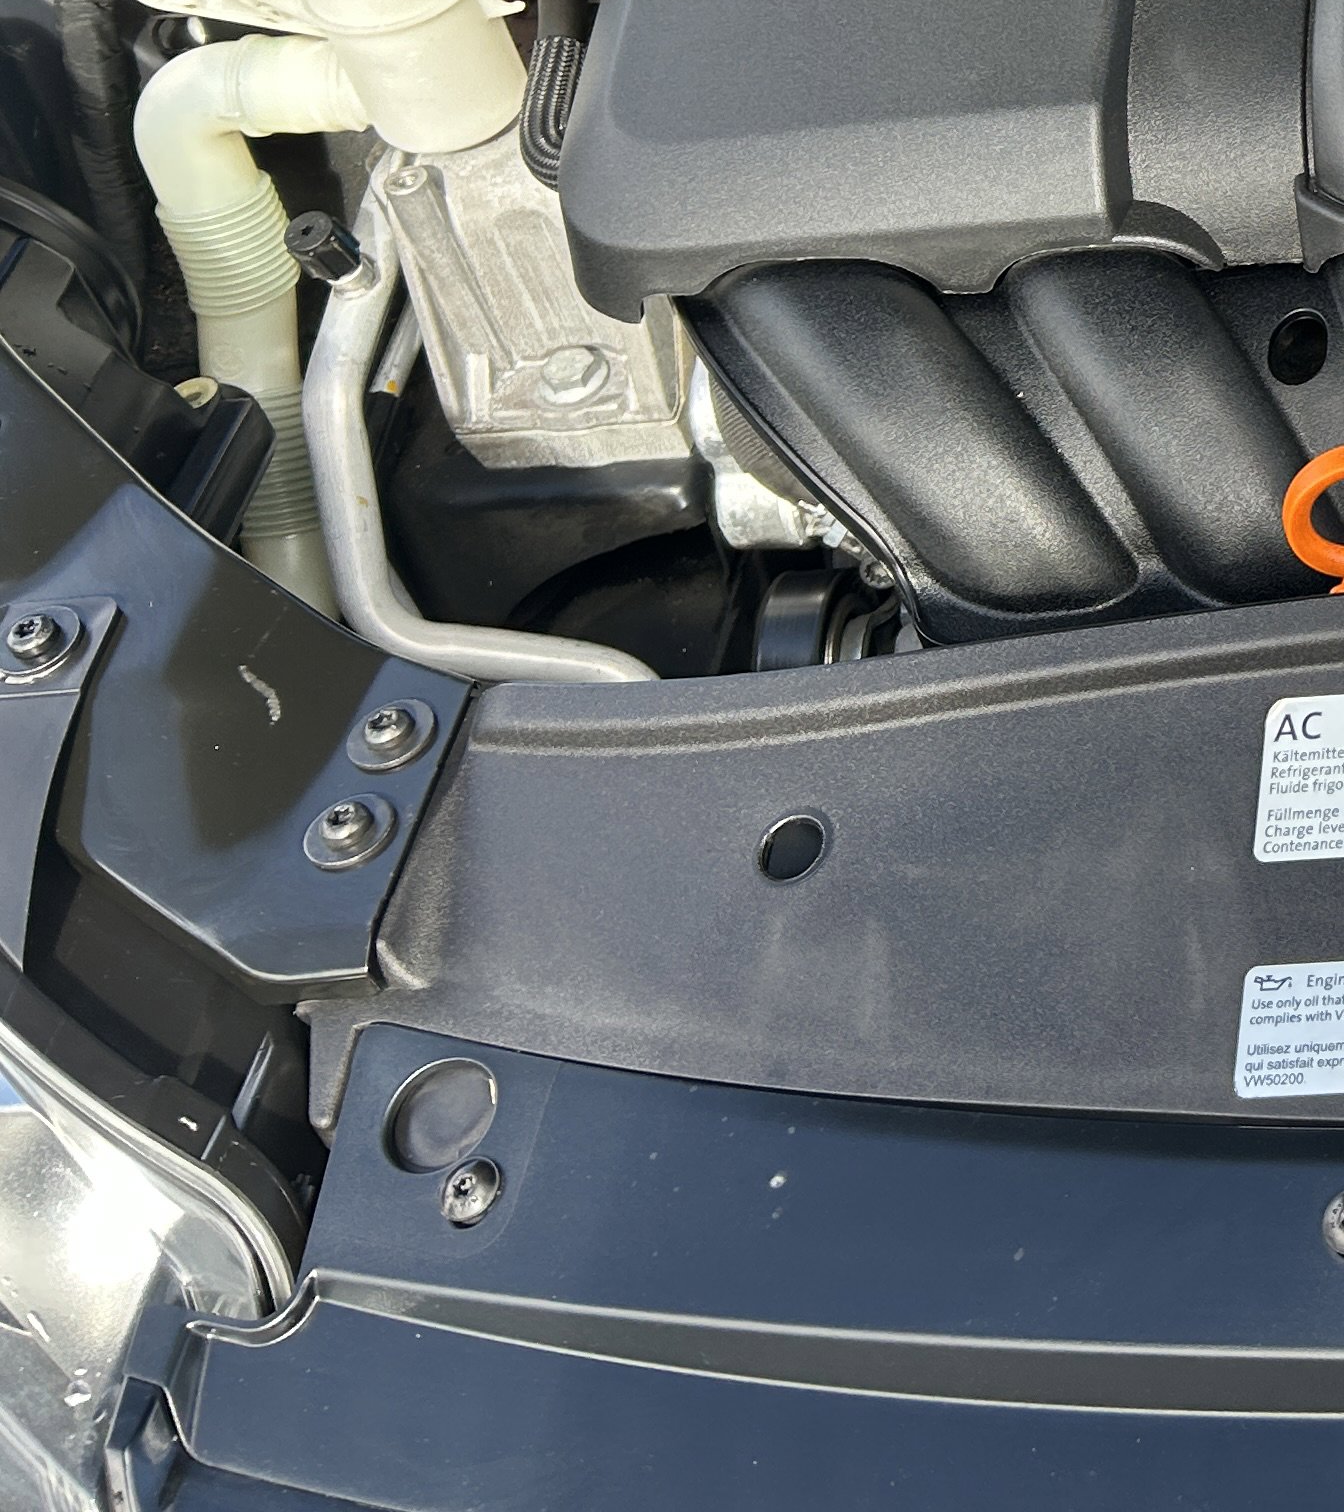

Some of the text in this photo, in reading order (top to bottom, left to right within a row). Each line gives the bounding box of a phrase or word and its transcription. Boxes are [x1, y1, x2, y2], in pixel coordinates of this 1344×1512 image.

[1273, 711, 1322, 742] AC
[1269, 780, 1309, 795] Fluide
[1266, 805, 1339, 825] Füllmenge
[1264, 822, 1313, 841] Charge
[1262, 837, 1343, 854] Contenance
[1251, 998, 1273, 1009] Use
[1275, 996, 1301, 1011] only
[1249, 1011, 1302, 1028] complies
[1304, 1010, 1332, 1022] with
[1246, 1042, 1290, 1055] Utilisez
[1244, 1060, 1263, 1073] qui
[1266, 1056, 1314, 1070] satisfait
